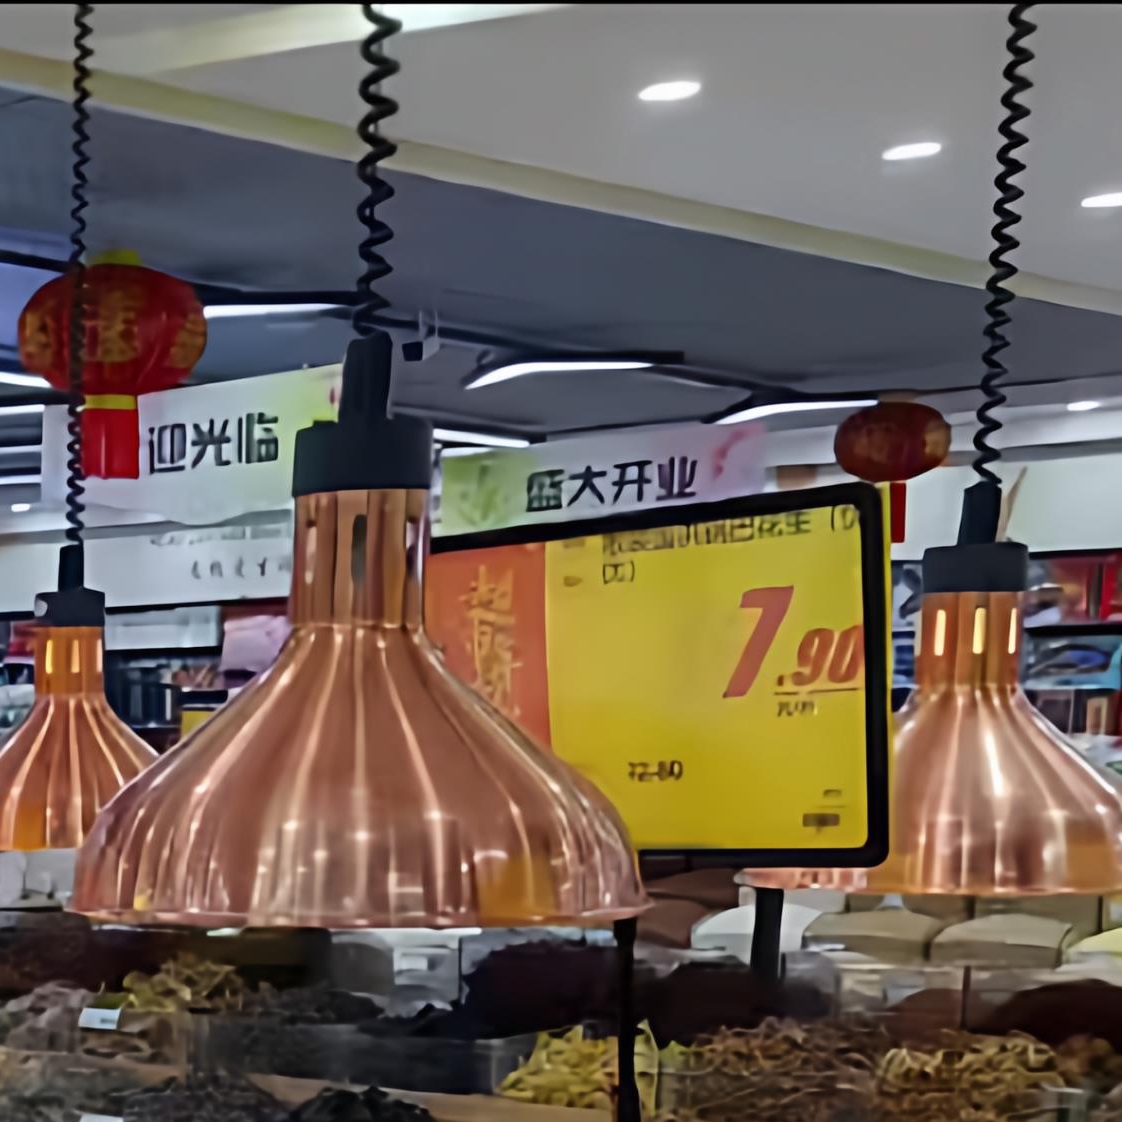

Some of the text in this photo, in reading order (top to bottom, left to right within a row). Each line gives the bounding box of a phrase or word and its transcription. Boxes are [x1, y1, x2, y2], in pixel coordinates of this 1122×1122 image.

[526, 456, 698, 512] 盛大开业
[722, 584, 863, 699] 7.90
